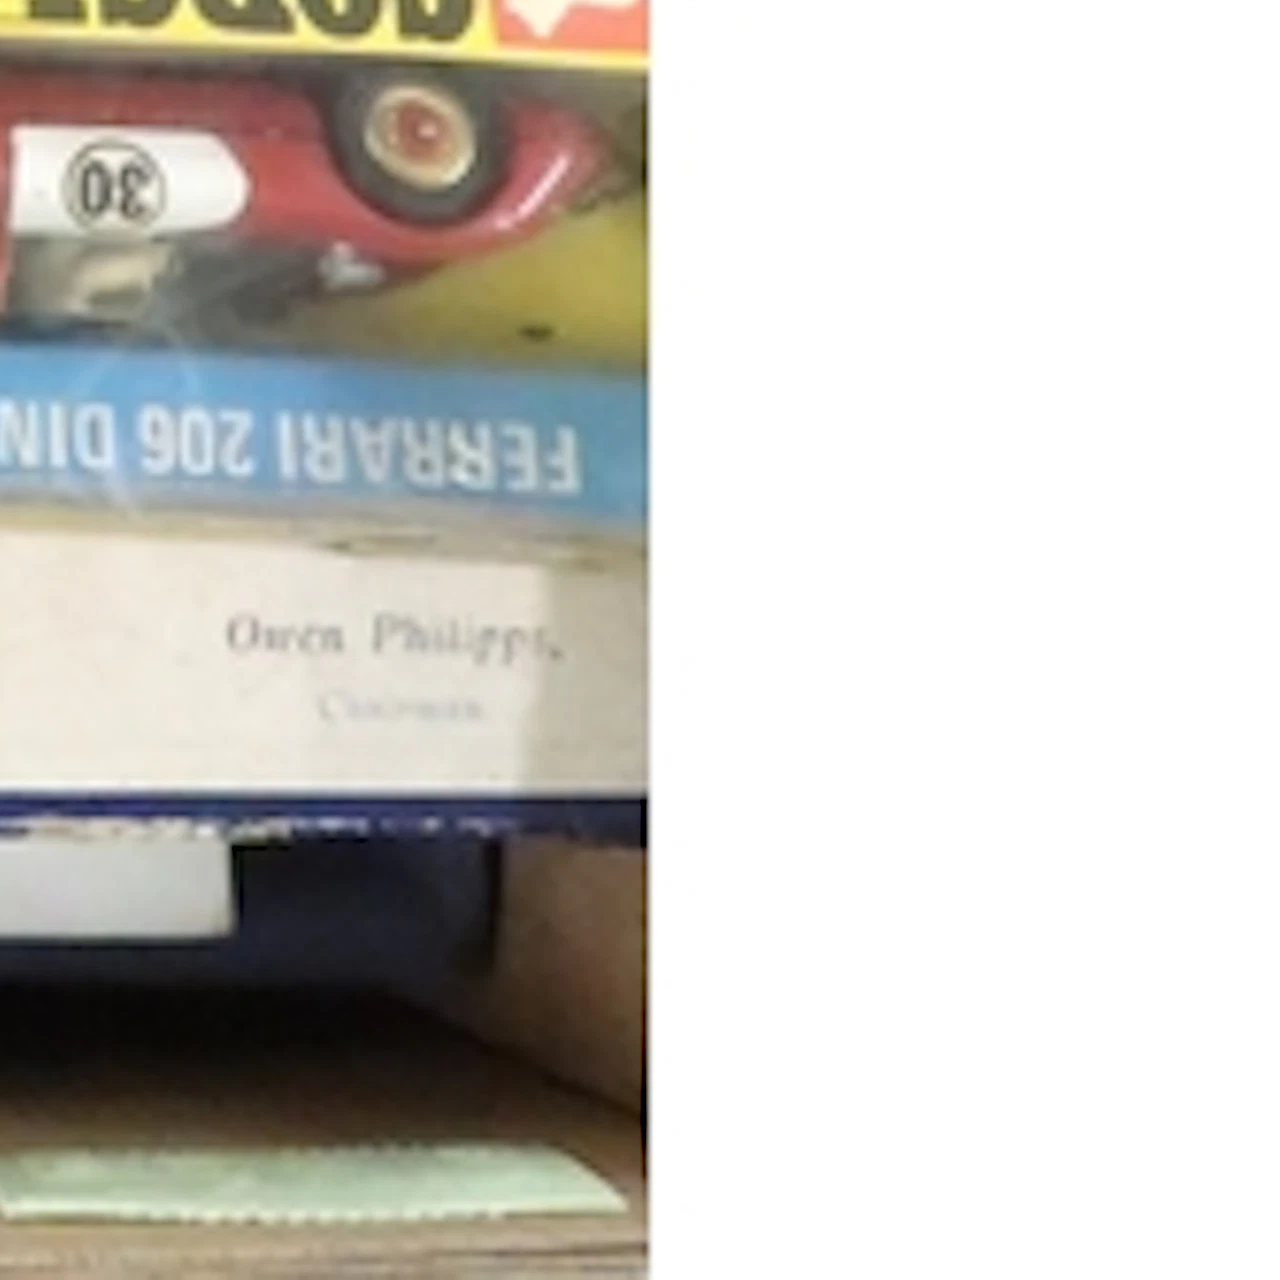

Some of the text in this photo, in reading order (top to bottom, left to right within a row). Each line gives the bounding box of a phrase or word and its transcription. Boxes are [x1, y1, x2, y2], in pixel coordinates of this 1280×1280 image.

[80, 157, 156, 219] 30
[140, 406, 254, 481] 206
[278, 409, 584, 495] FERRARI
[225, 612, 345, 655] Owen
